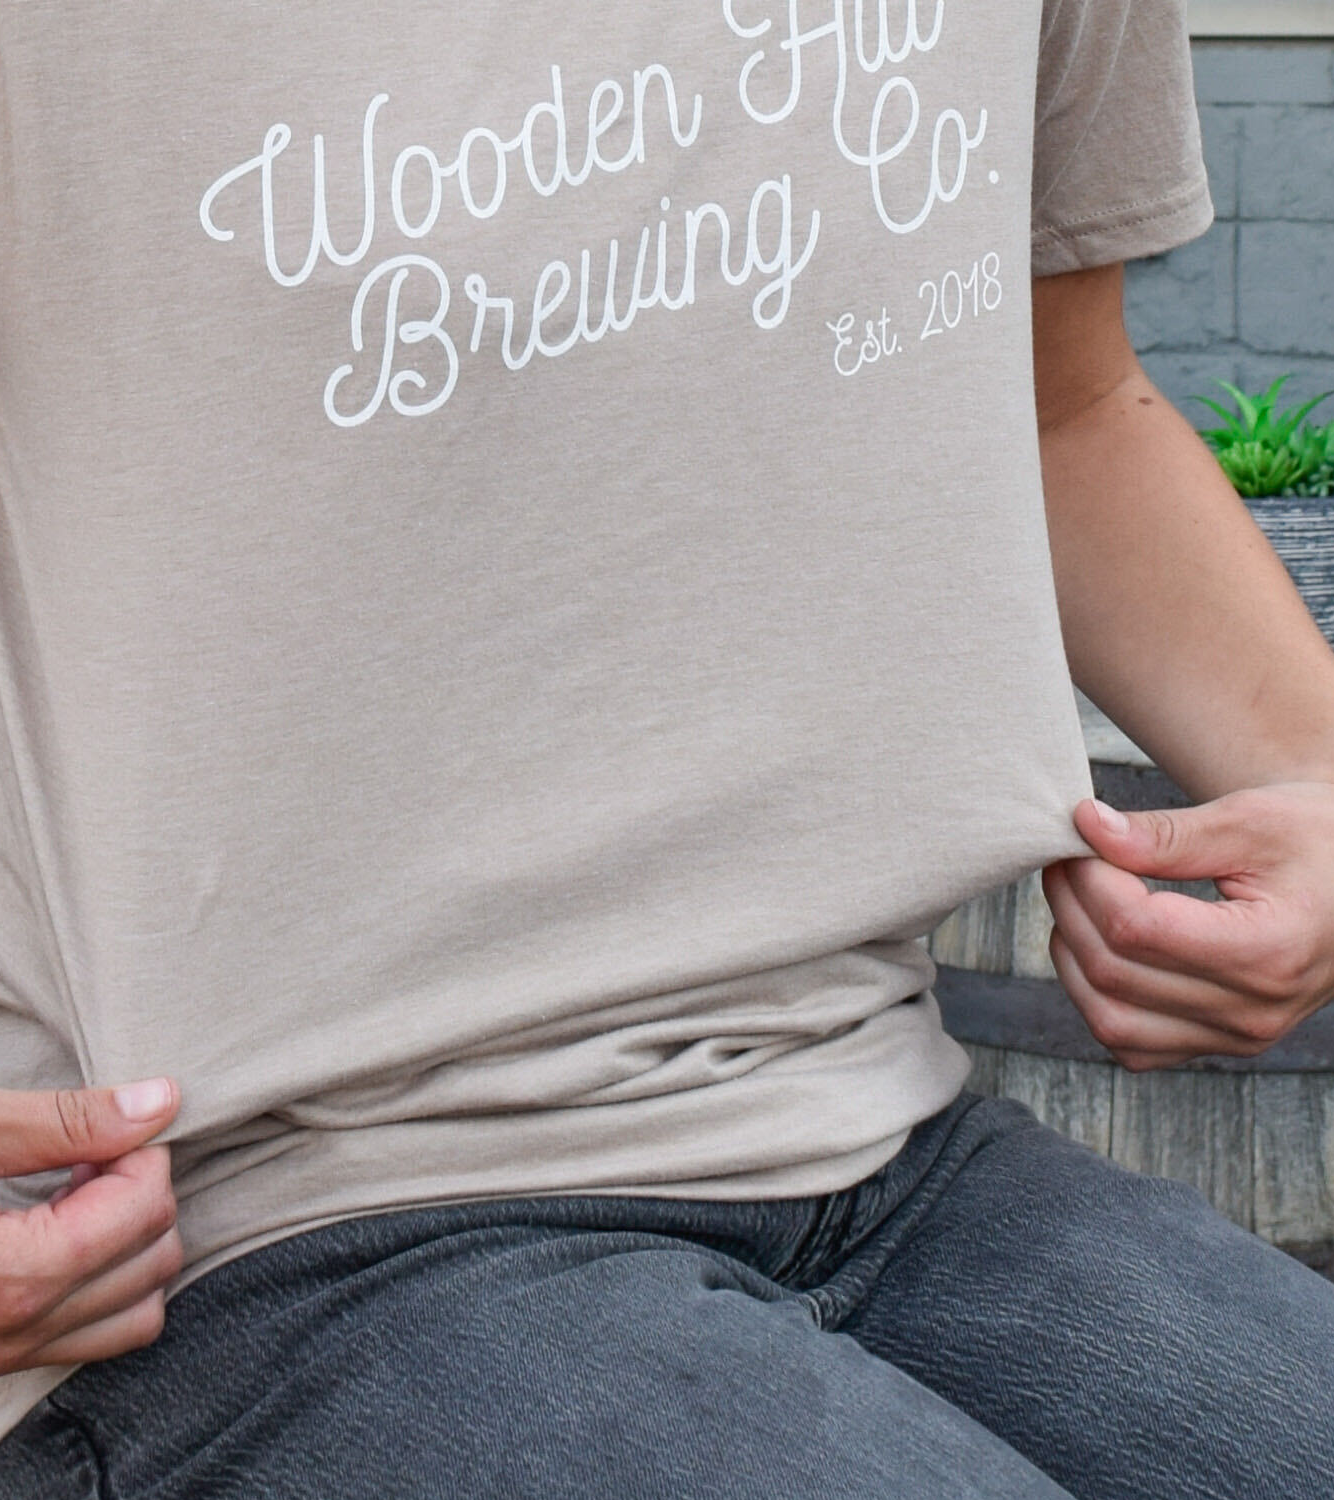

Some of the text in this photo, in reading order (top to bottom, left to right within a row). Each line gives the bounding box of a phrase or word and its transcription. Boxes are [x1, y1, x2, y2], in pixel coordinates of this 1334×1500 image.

[200, 64, 702, 288] Wooden
[323, 76, 1000, 428] Brewing Co.
[825, 251, 1003, 377] Est. 2018
